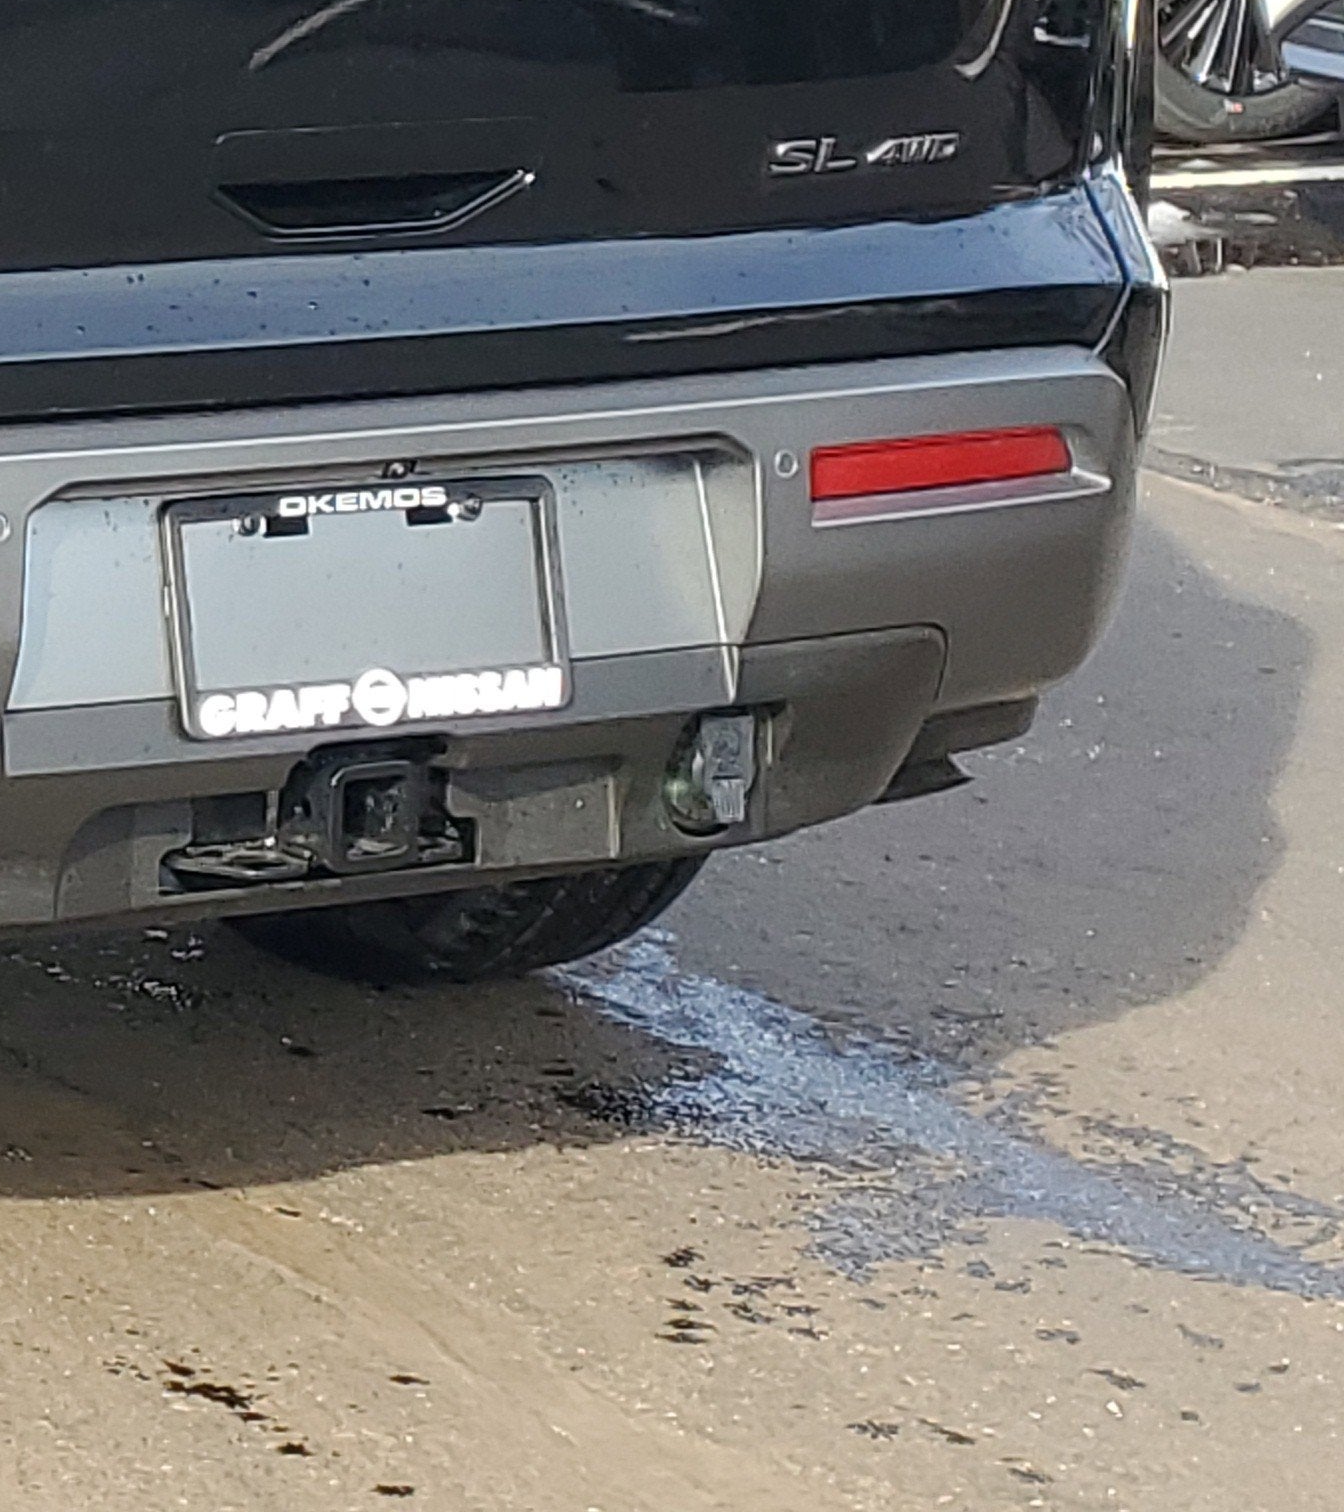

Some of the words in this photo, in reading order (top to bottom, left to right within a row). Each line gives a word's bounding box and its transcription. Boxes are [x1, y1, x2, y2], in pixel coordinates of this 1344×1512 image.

[769, 138, 857, 172] SL
[278, 486, 447, 517] OKEMOS
[199, 683, 351, 737] GRAFF
